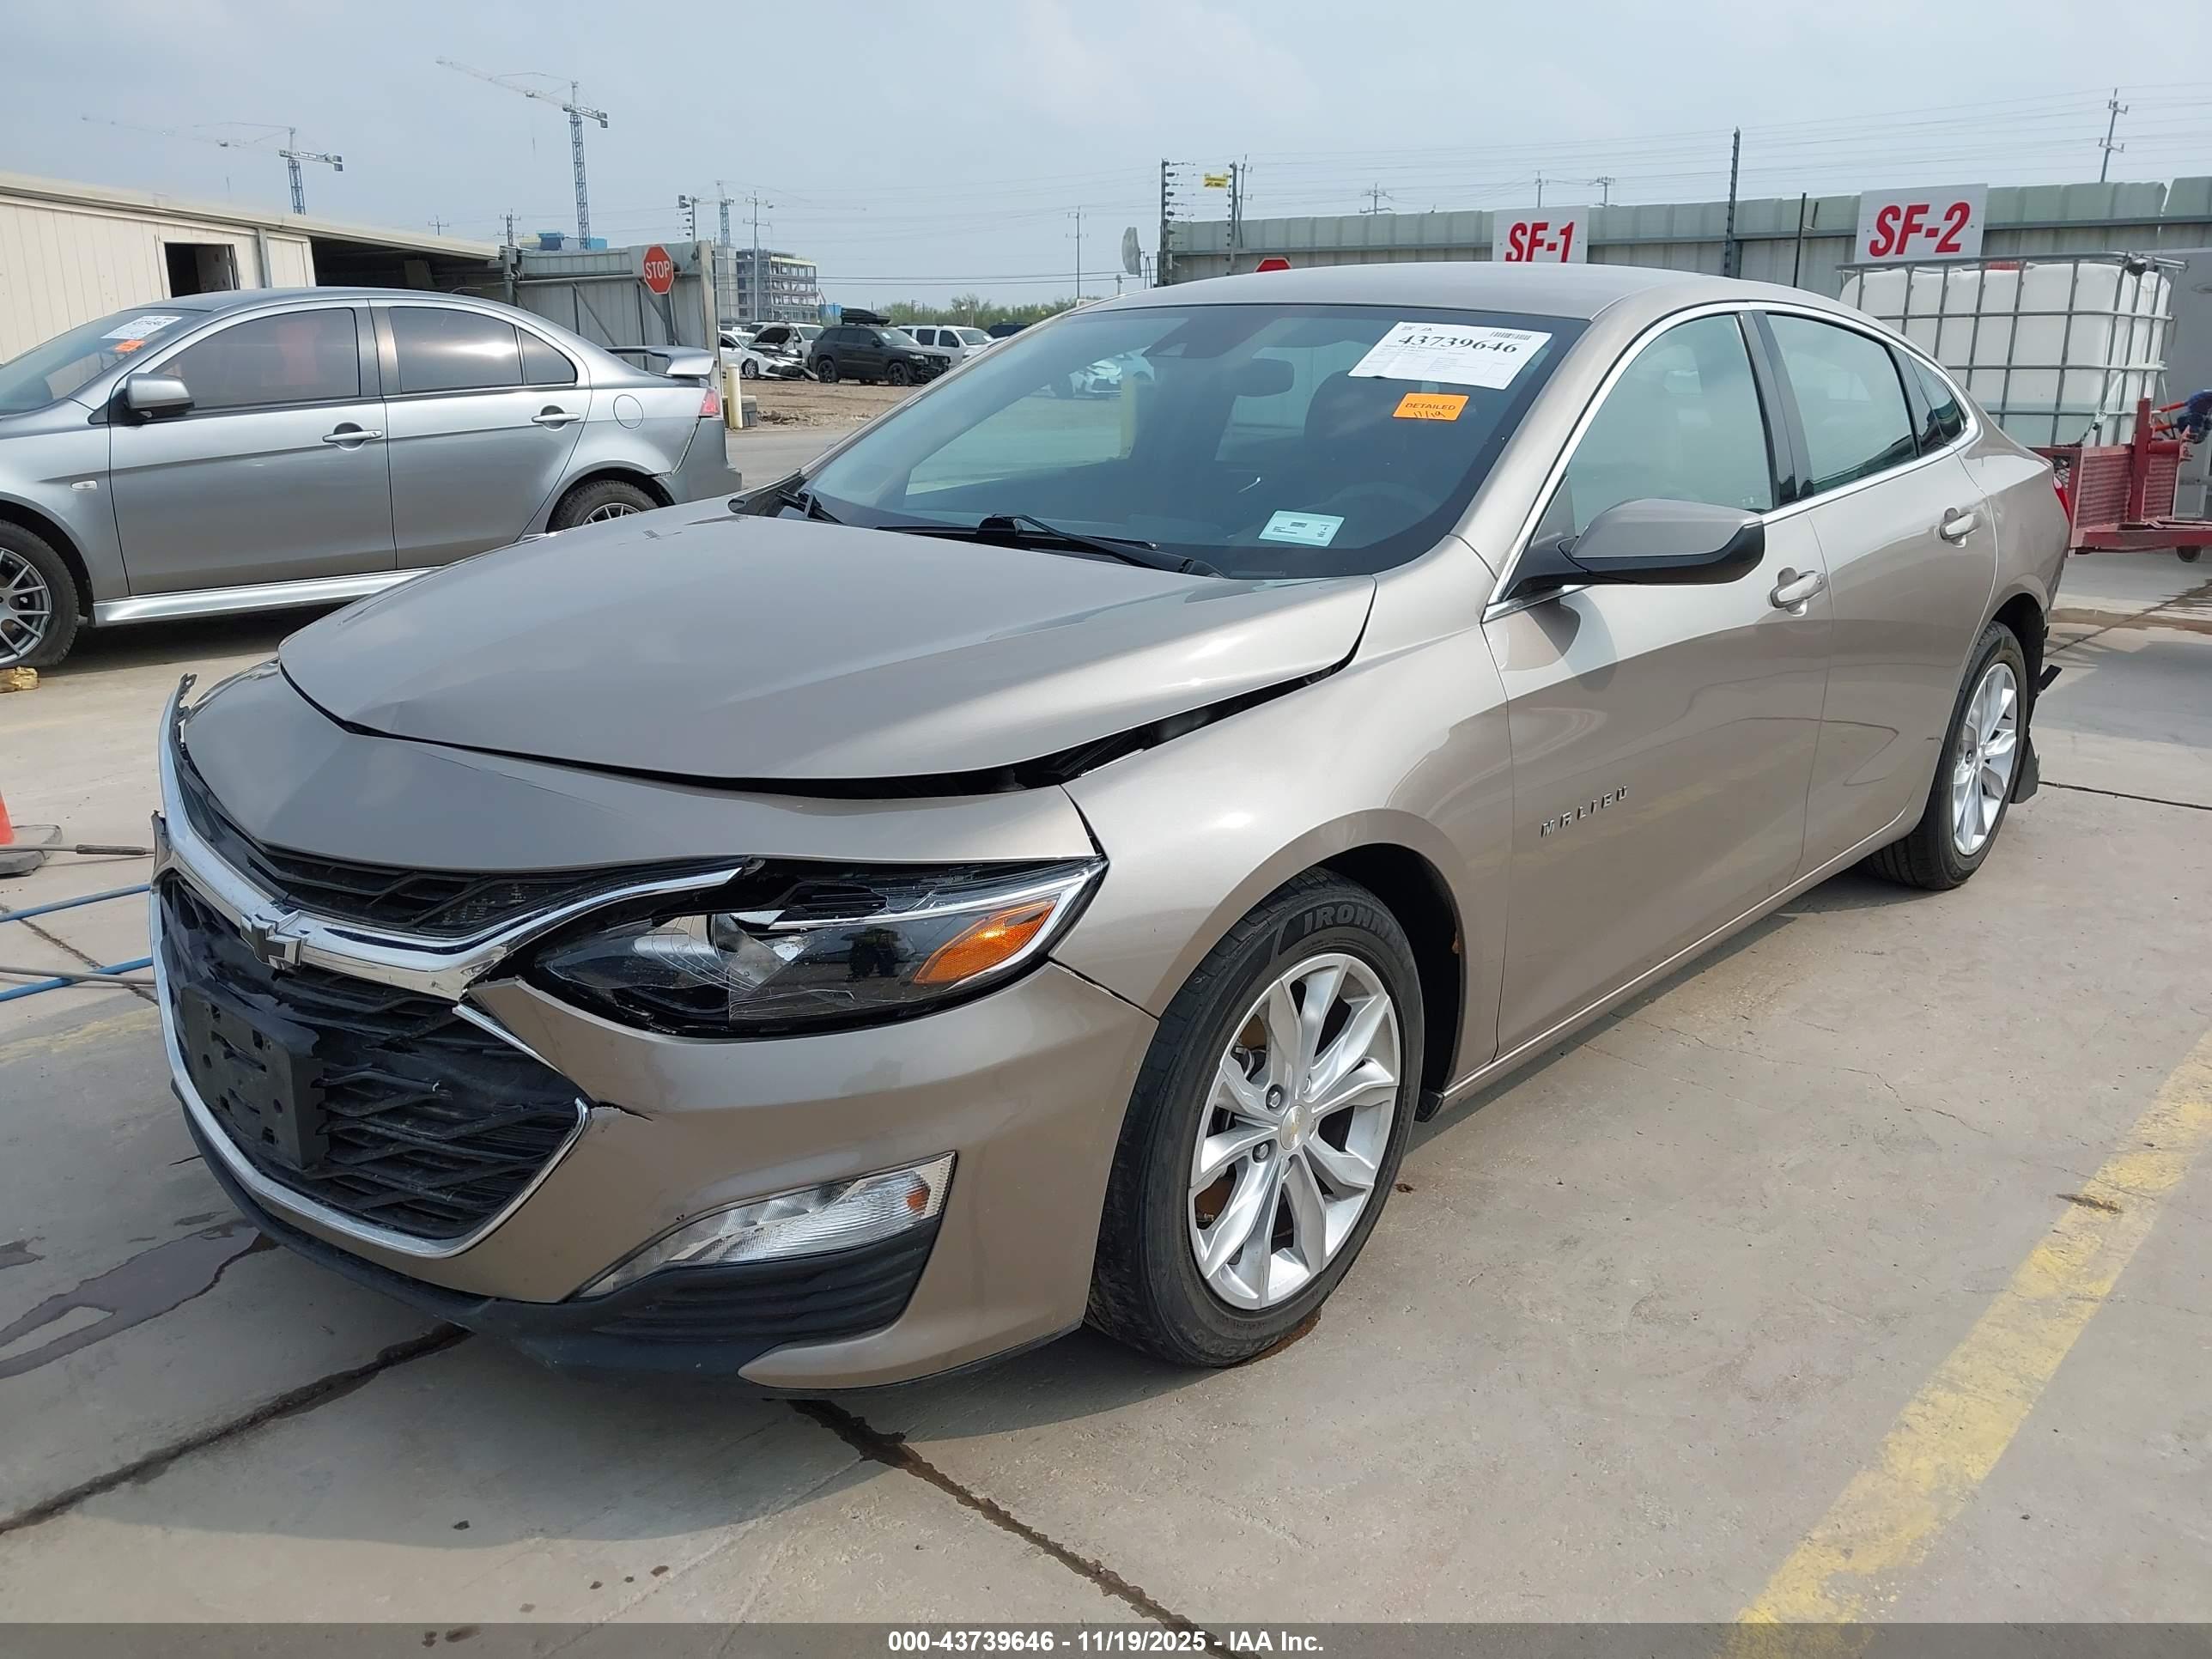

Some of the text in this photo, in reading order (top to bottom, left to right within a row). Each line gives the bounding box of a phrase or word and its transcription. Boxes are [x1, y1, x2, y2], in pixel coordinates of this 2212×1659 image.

[1504, 222, 1575, 263] SF-1
[1869, 202, 1971, 257] SF-2
[645, 260, 671, 279] STOP
[1397, 333, 1517, 354] 43739646
[1540, 786, 1628, 838] MALIBU
